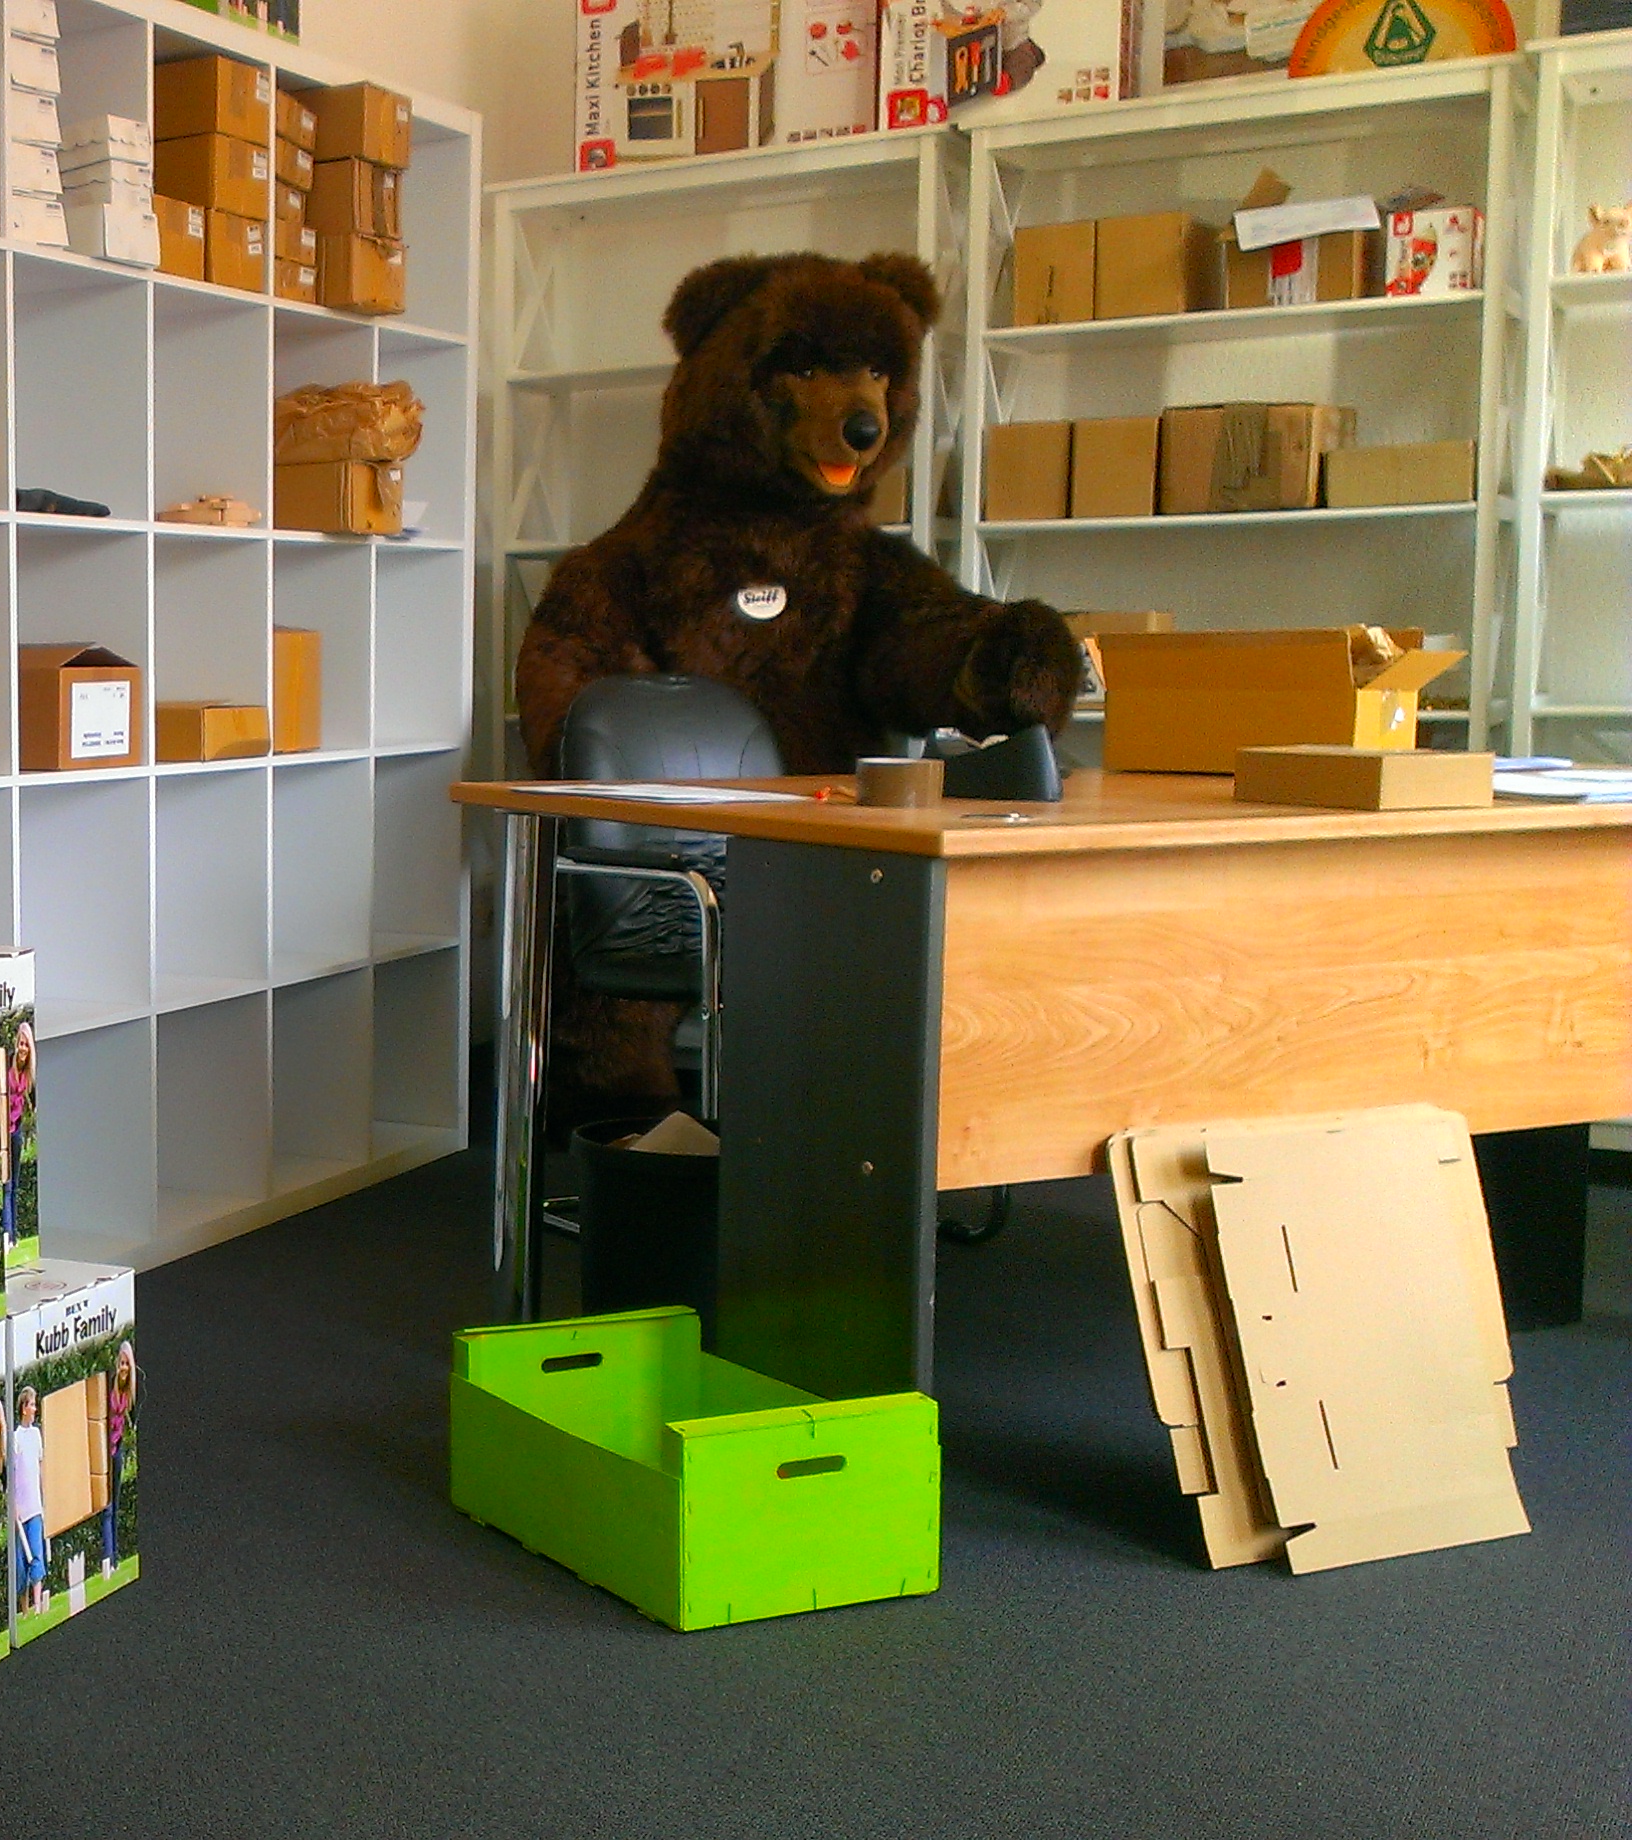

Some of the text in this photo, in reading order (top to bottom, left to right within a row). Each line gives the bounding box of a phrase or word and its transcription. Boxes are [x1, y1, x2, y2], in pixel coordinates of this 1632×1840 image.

[585, 18, 601, 135] Maxi Kitchen
[909, 21, 925, 83] Chariot
[35, 1302, 117, 1359] Kubb Family
